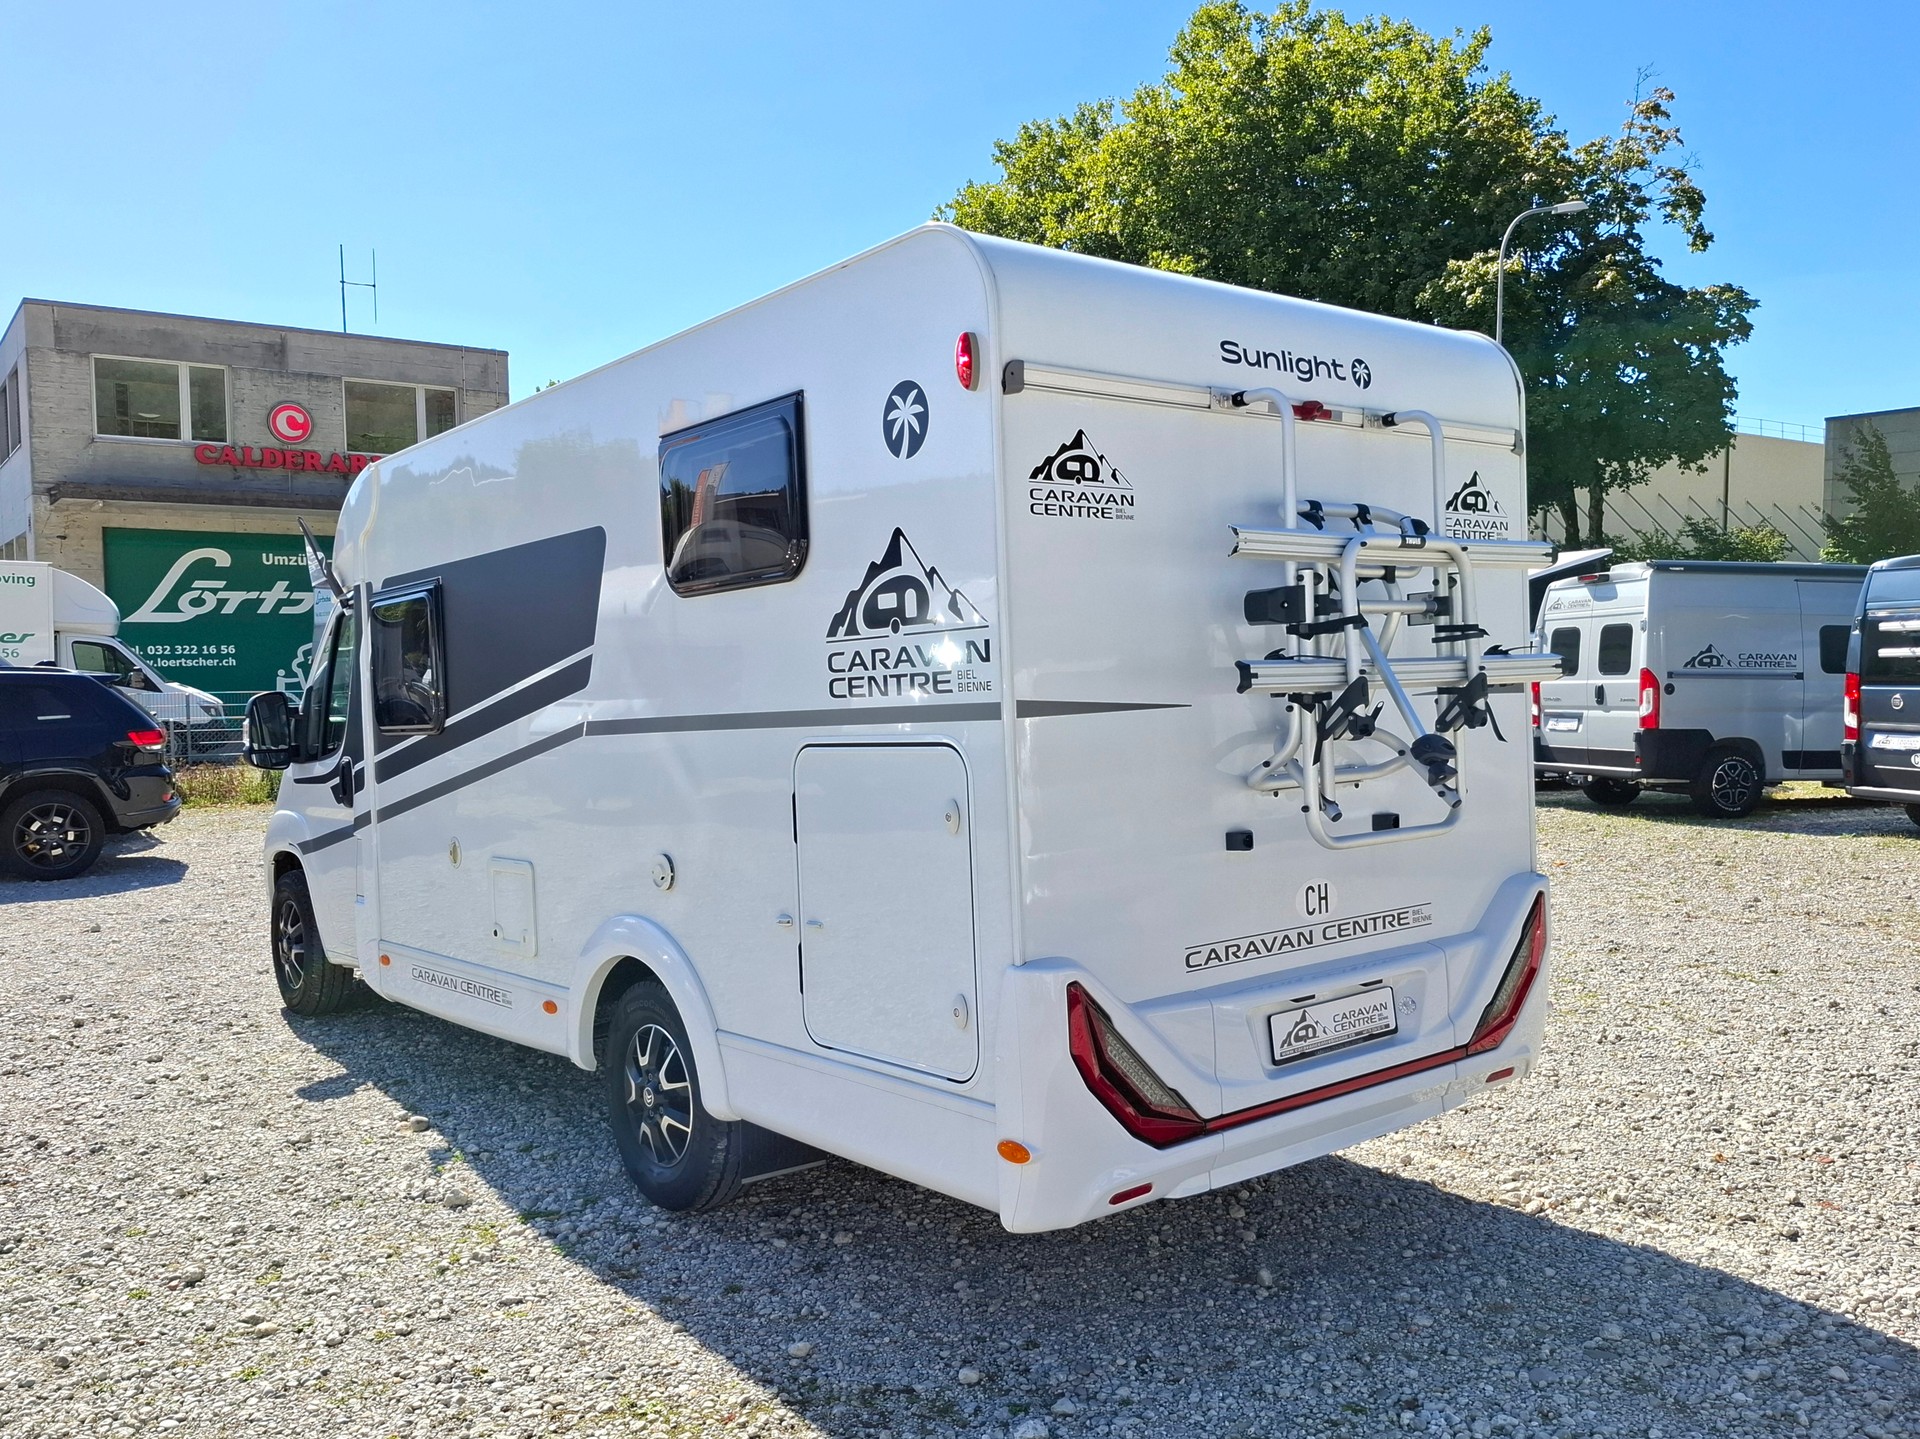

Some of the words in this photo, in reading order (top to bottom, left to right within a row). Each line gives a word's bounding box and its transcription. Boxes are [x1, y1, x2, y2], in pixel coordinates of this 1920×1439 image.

[1220, 340, 1346, 382] Sunlight
[194, 444, 383, 474] CALDERAR
[1029, 488, 1135, 506] CARAVAN
[1030, 503, 1113, 519] CENTRE
[1446, 517, 1508, 531] CARAVAN
[1446, 529, 1496, 540] CENTRE
[262, 553, 306, 566] Umzü
[121, 548, 314, 623] Lörts
[0, 633, 35, 643] er
[147, 645, 171, 655] 032
[175, 645, 198, 654] 322
[202, 645, 217, 654] 16
[220, 645, 236, 654] 56
[828, 639, 991, 673] CARAVN
[1738, 653, 1797, 661] CARAVAN
[146, 657, 236, 667] w.loertscher.ch
[1738, 660, 1784, 668] CENTRE
[957, 670, 977, 680] BIEL
[829, 671, 953, 699] CENTRE
[957, 681, 992, 692] BIENNE
[1304, 883, 1329, 916] CH
[1185, 930, 1314, 969] CARAVAN
[1322, 911, 1411, 941] CENTRE
[412, 967, 457, 990] CARAVAN
[460, 981, 502, 1003] CENTRE
[1333, 1002, 1388, 1024] CARAVAN
[1334, 1015, 1378, 1033] CENTRE
